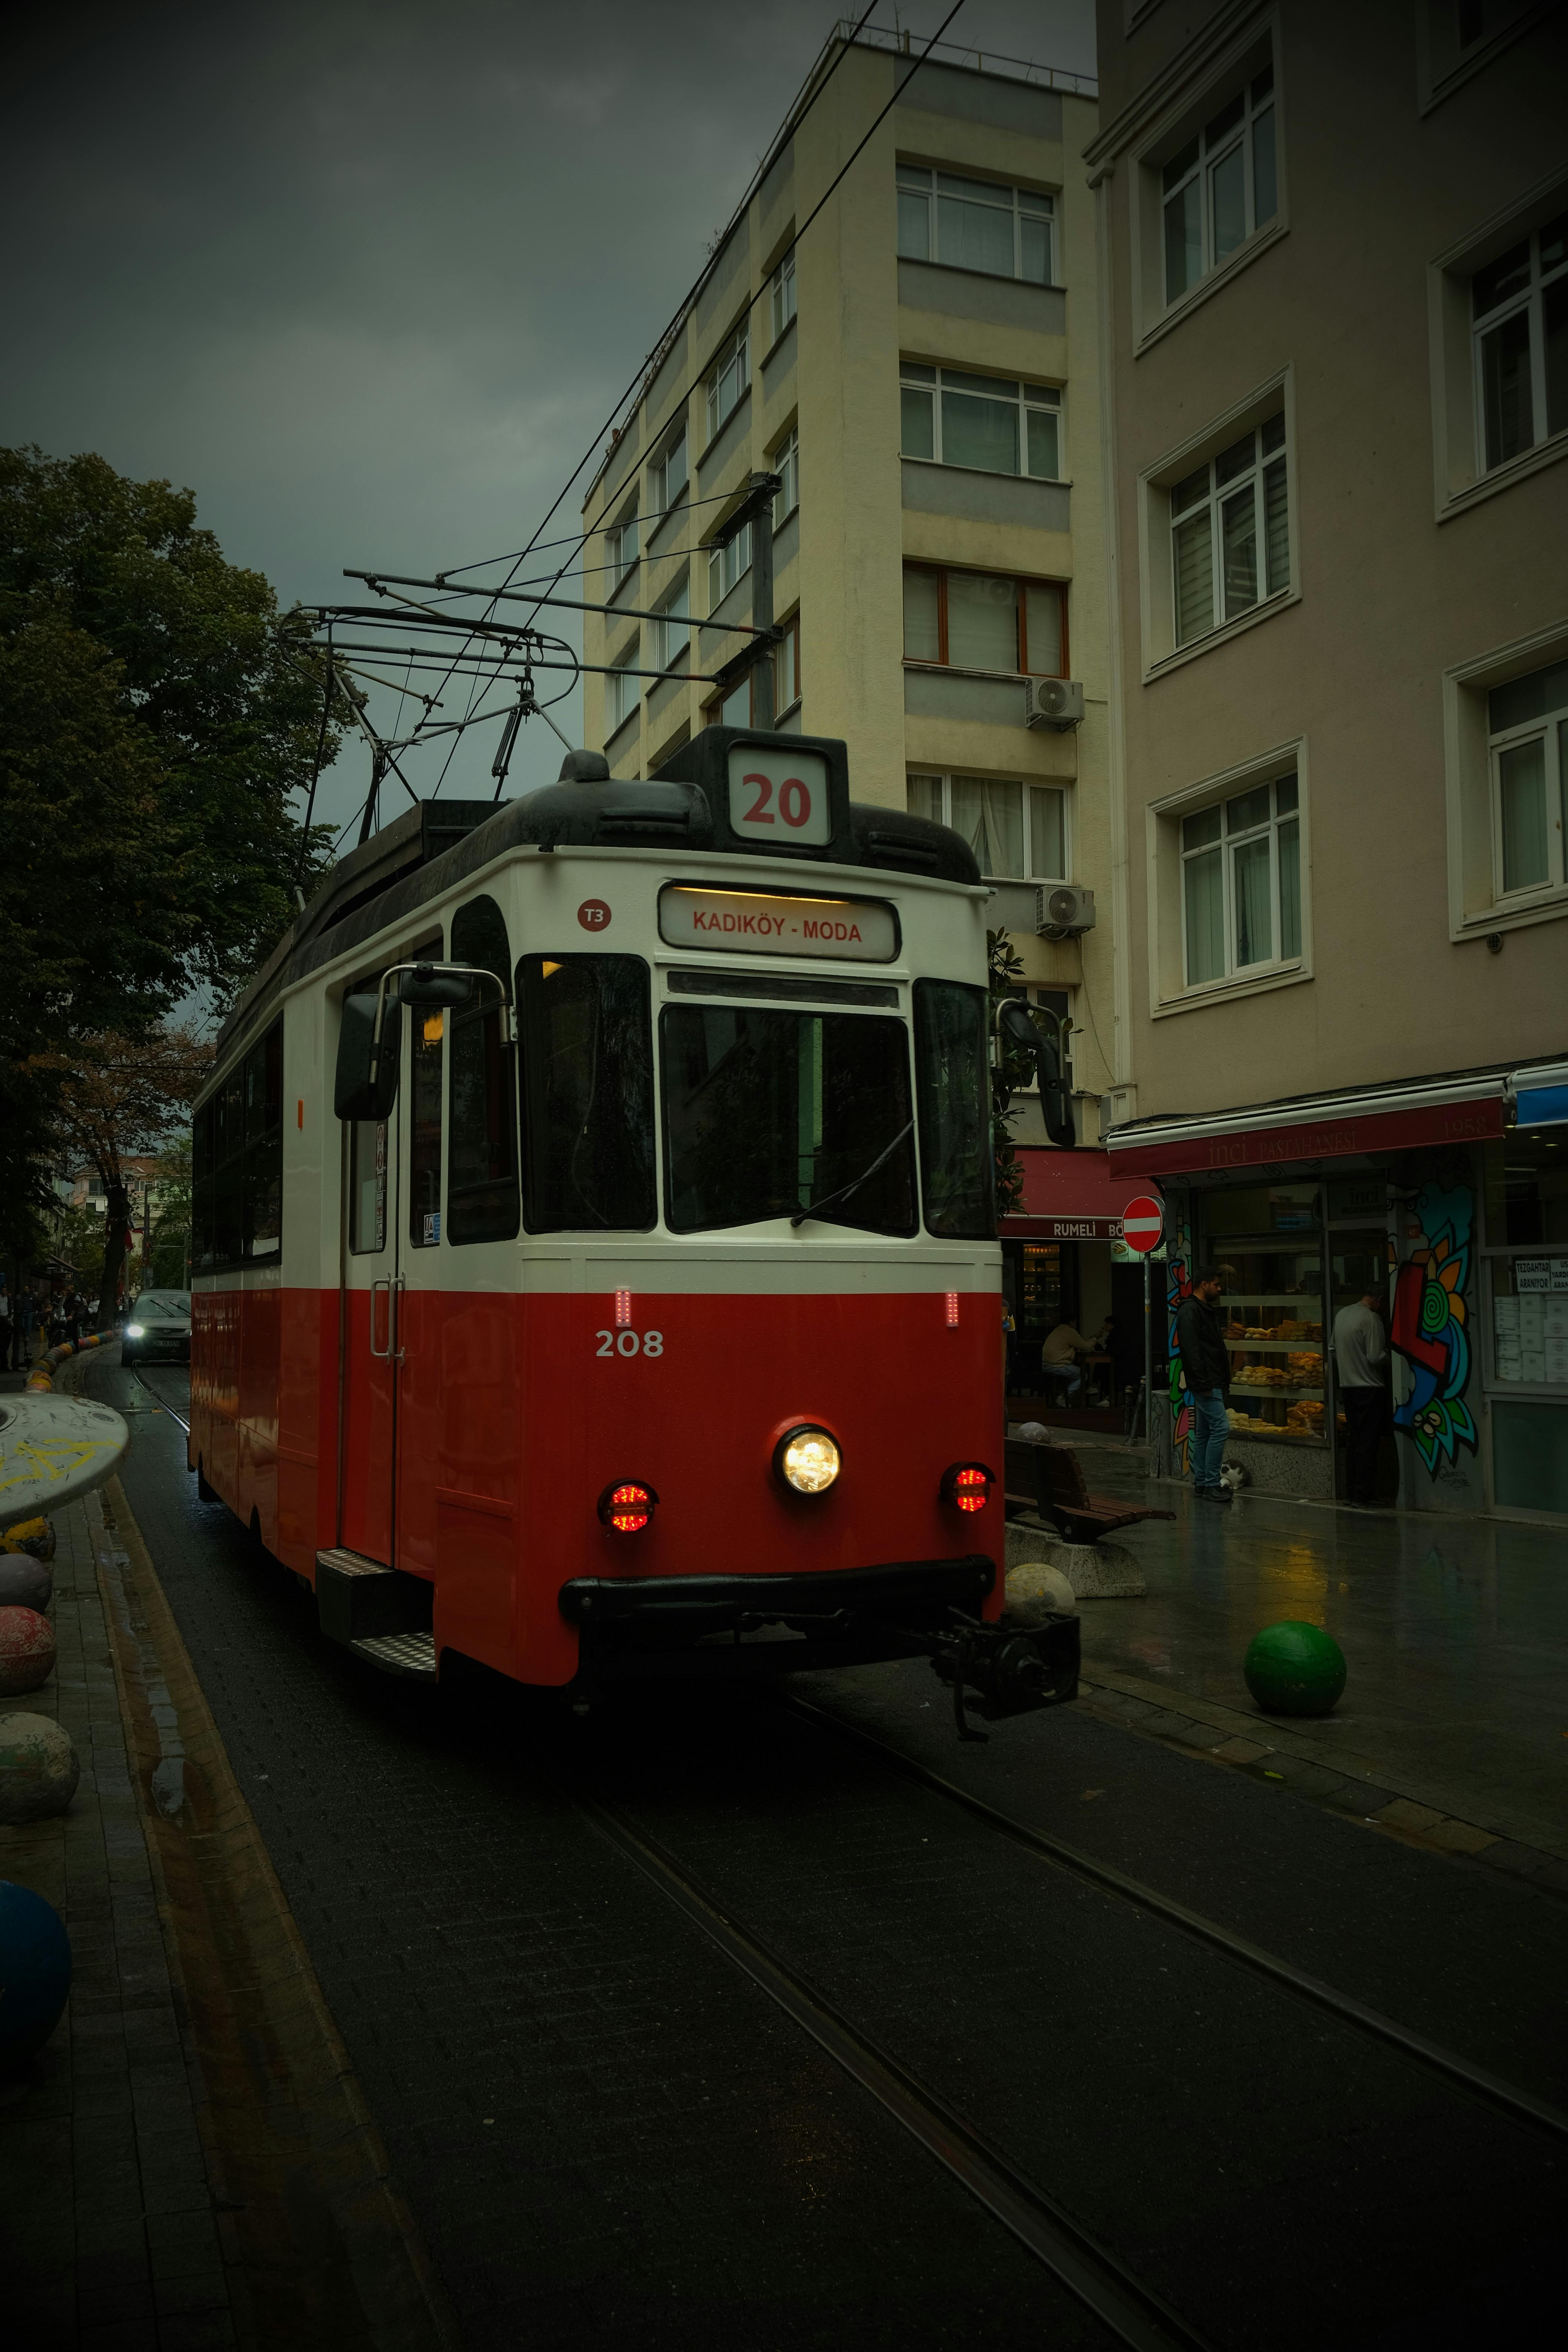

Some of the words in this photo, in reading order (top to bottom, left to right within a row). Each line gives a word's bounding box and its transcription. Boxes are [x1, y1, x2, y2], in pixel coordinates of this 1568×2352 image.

[741, 773, 812, 828] 20
[584, 908, 603, 922] T3
[693, 911, 785, 936] KADIKÖY
[804, 920, 862, 942] MODA
[1443, 1115, 1487, 1138] 1958
[1054, 1221, 1096, 1236] RUMELİ
[1109, 1221, 1124, 1237] BÖ
[1517, 1263, 1550, 1273] TEZGAHTAR
[1520, 1279, 1548, 1288] ARANIYOR
[595, 1330, 664, 1357] 208
